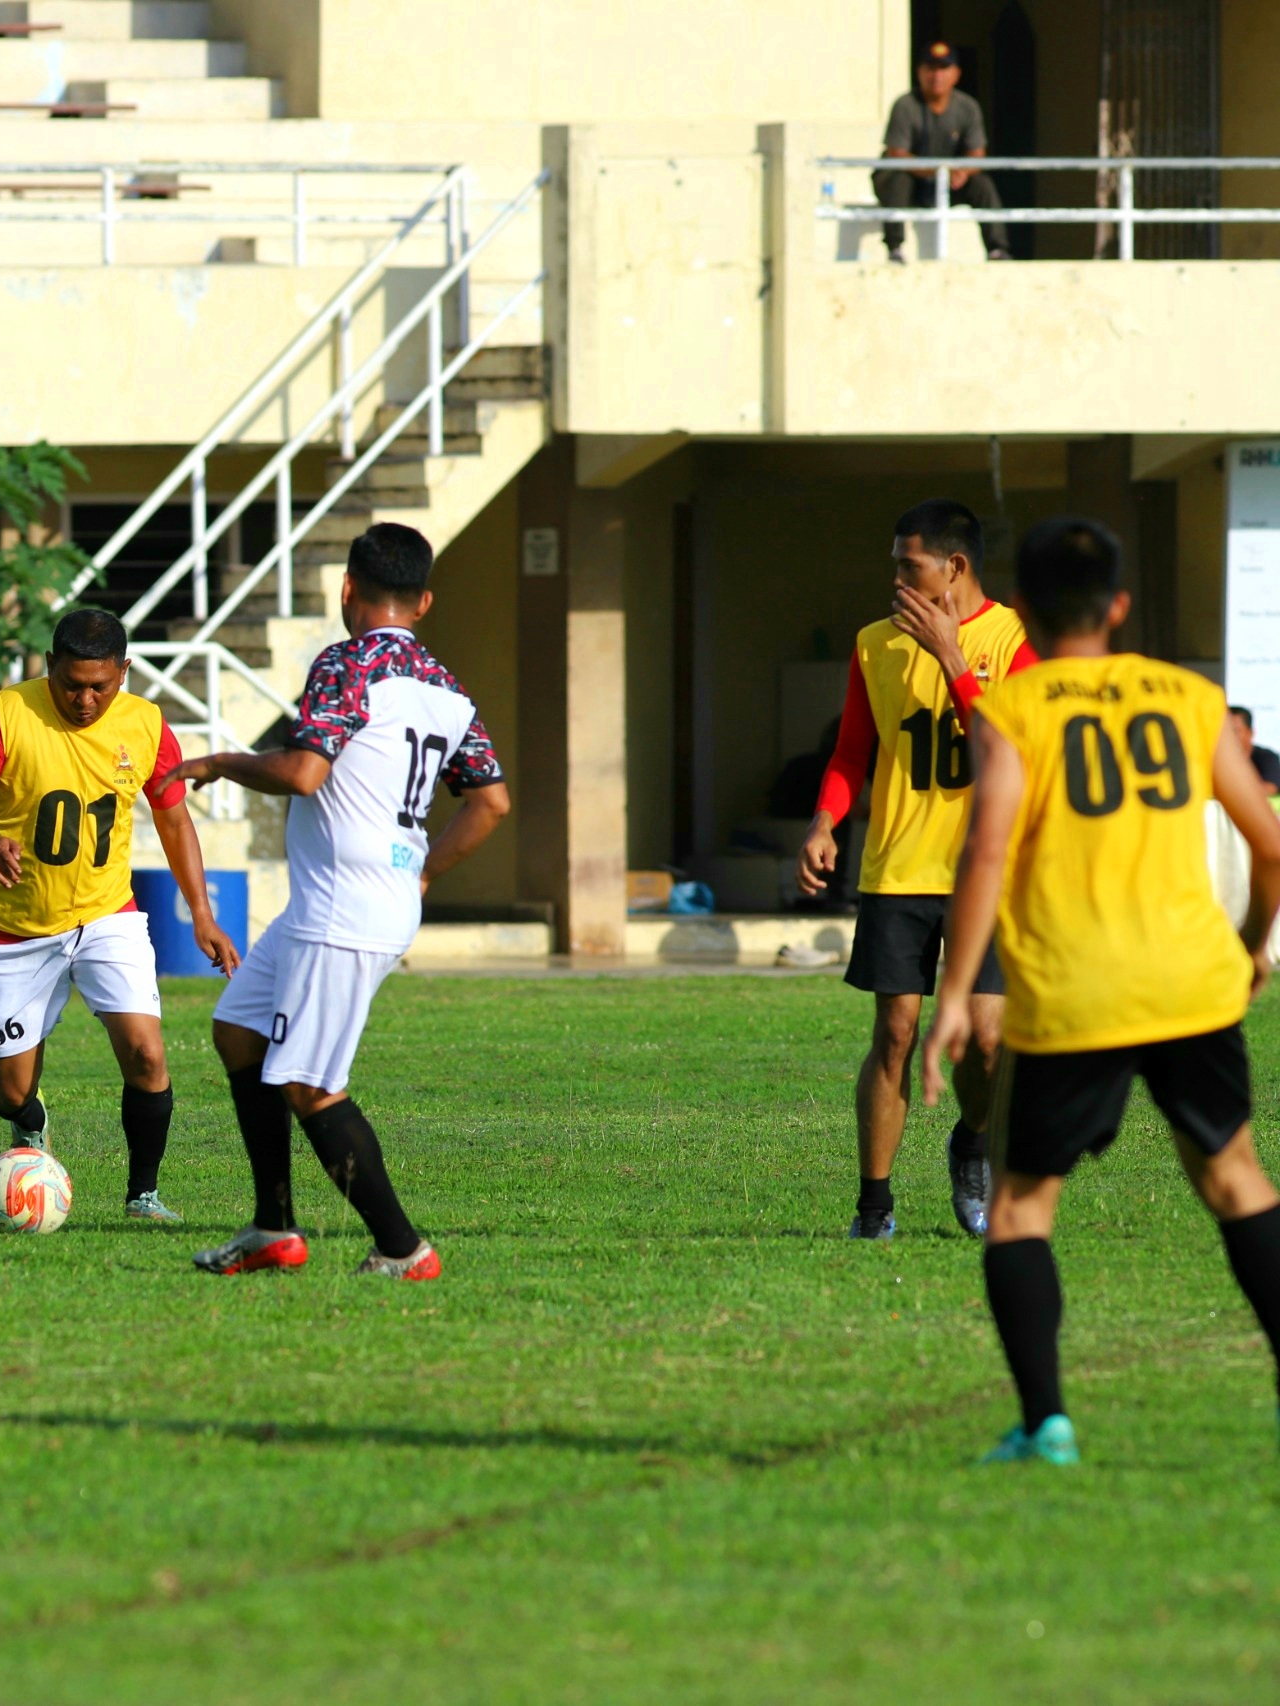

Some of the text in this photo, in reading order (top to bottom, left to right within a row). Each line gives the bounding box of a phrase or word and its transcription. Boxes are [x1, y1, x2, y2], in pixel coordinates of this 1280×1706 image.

[397, 726, 448, 832] 10
[900, 707, 977, 790] 16
[1064, 712, 1191, 816] 09
[34, 789, 117, 867] 01
